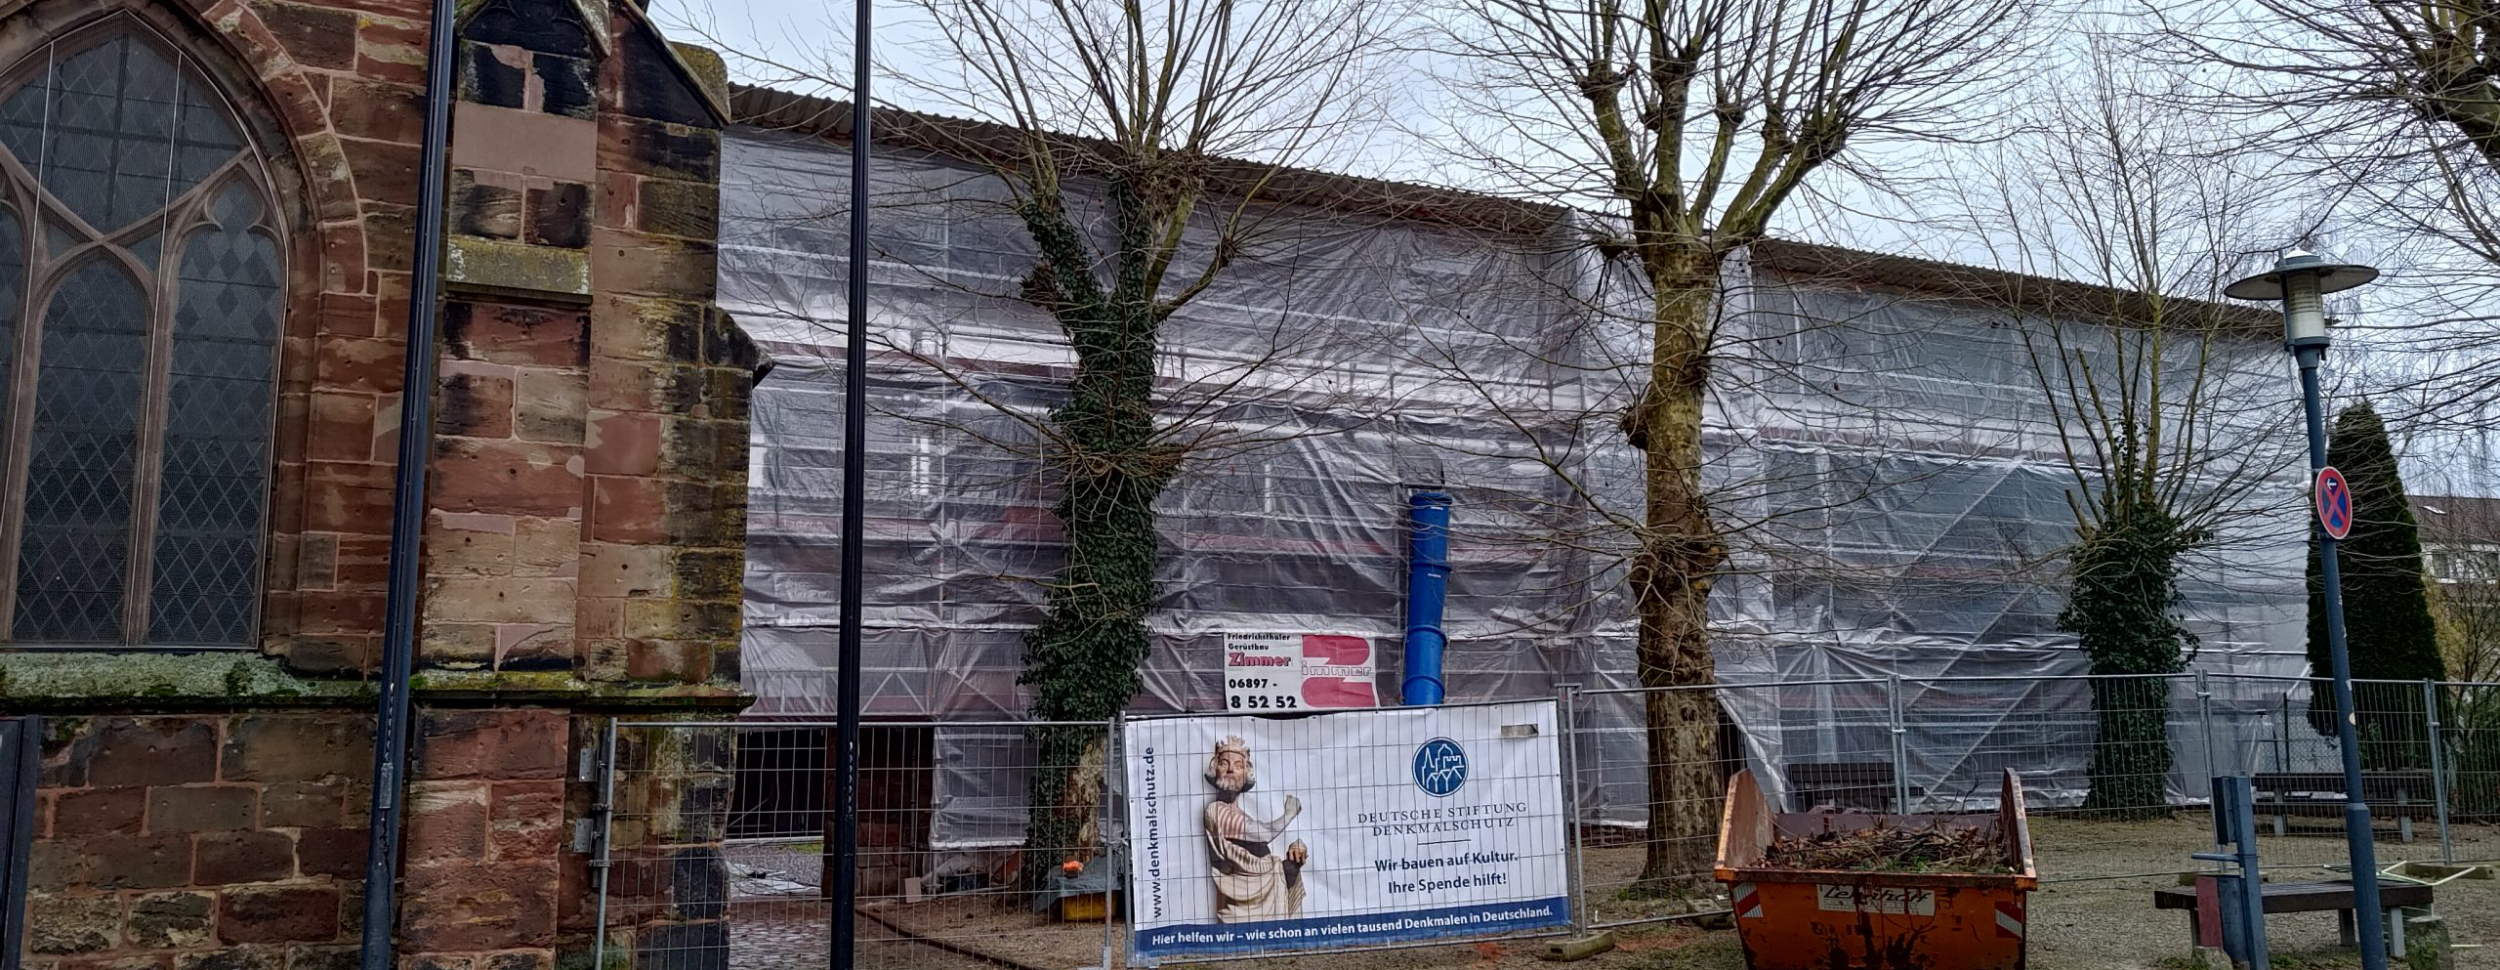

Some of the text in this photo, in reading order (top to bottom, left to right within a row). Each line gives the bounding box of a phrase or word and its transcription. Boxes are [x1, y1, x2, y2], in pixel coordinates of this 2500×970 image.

[1227, 632, 1291, 641] Friedrichsthaler
[1228, 652, 1292, 667] Zimmer
[1228, 678, 1269, 689] 06897
[1231, 695, 1298, 709] 8 52 52
[1358, 802, 1528, 824] DEUTSCHE STIFTUNG
[1143, 746, 1162, 919] www.denkmalschutz.de
[1373, 818, 1516, 837] DENKMALSCHUTZ
[1375, 850, 1519, 872] Wir bauen auf Kultur.
[1388, 872, 1507, 894] Ihre Spende hilft!
[1152, 933, 1175, 946] Hier
[1177, 931, 1214, 944] helfen
[1216, 930, 1235, 943] wir
[1245, 928, 1266, 941] wie
[1268, 926, 1301, 940] schon
[1304, 927, 1319, 938] an
[1320, 922, 1356, 936] vielen
[1357, 918, 1402, 934] tausend
[1404, 913, 1468, 929] Denkmalen
[1470, 911, 1481, 924] in
[1482, 905, 1553, 922] Deutschland.
